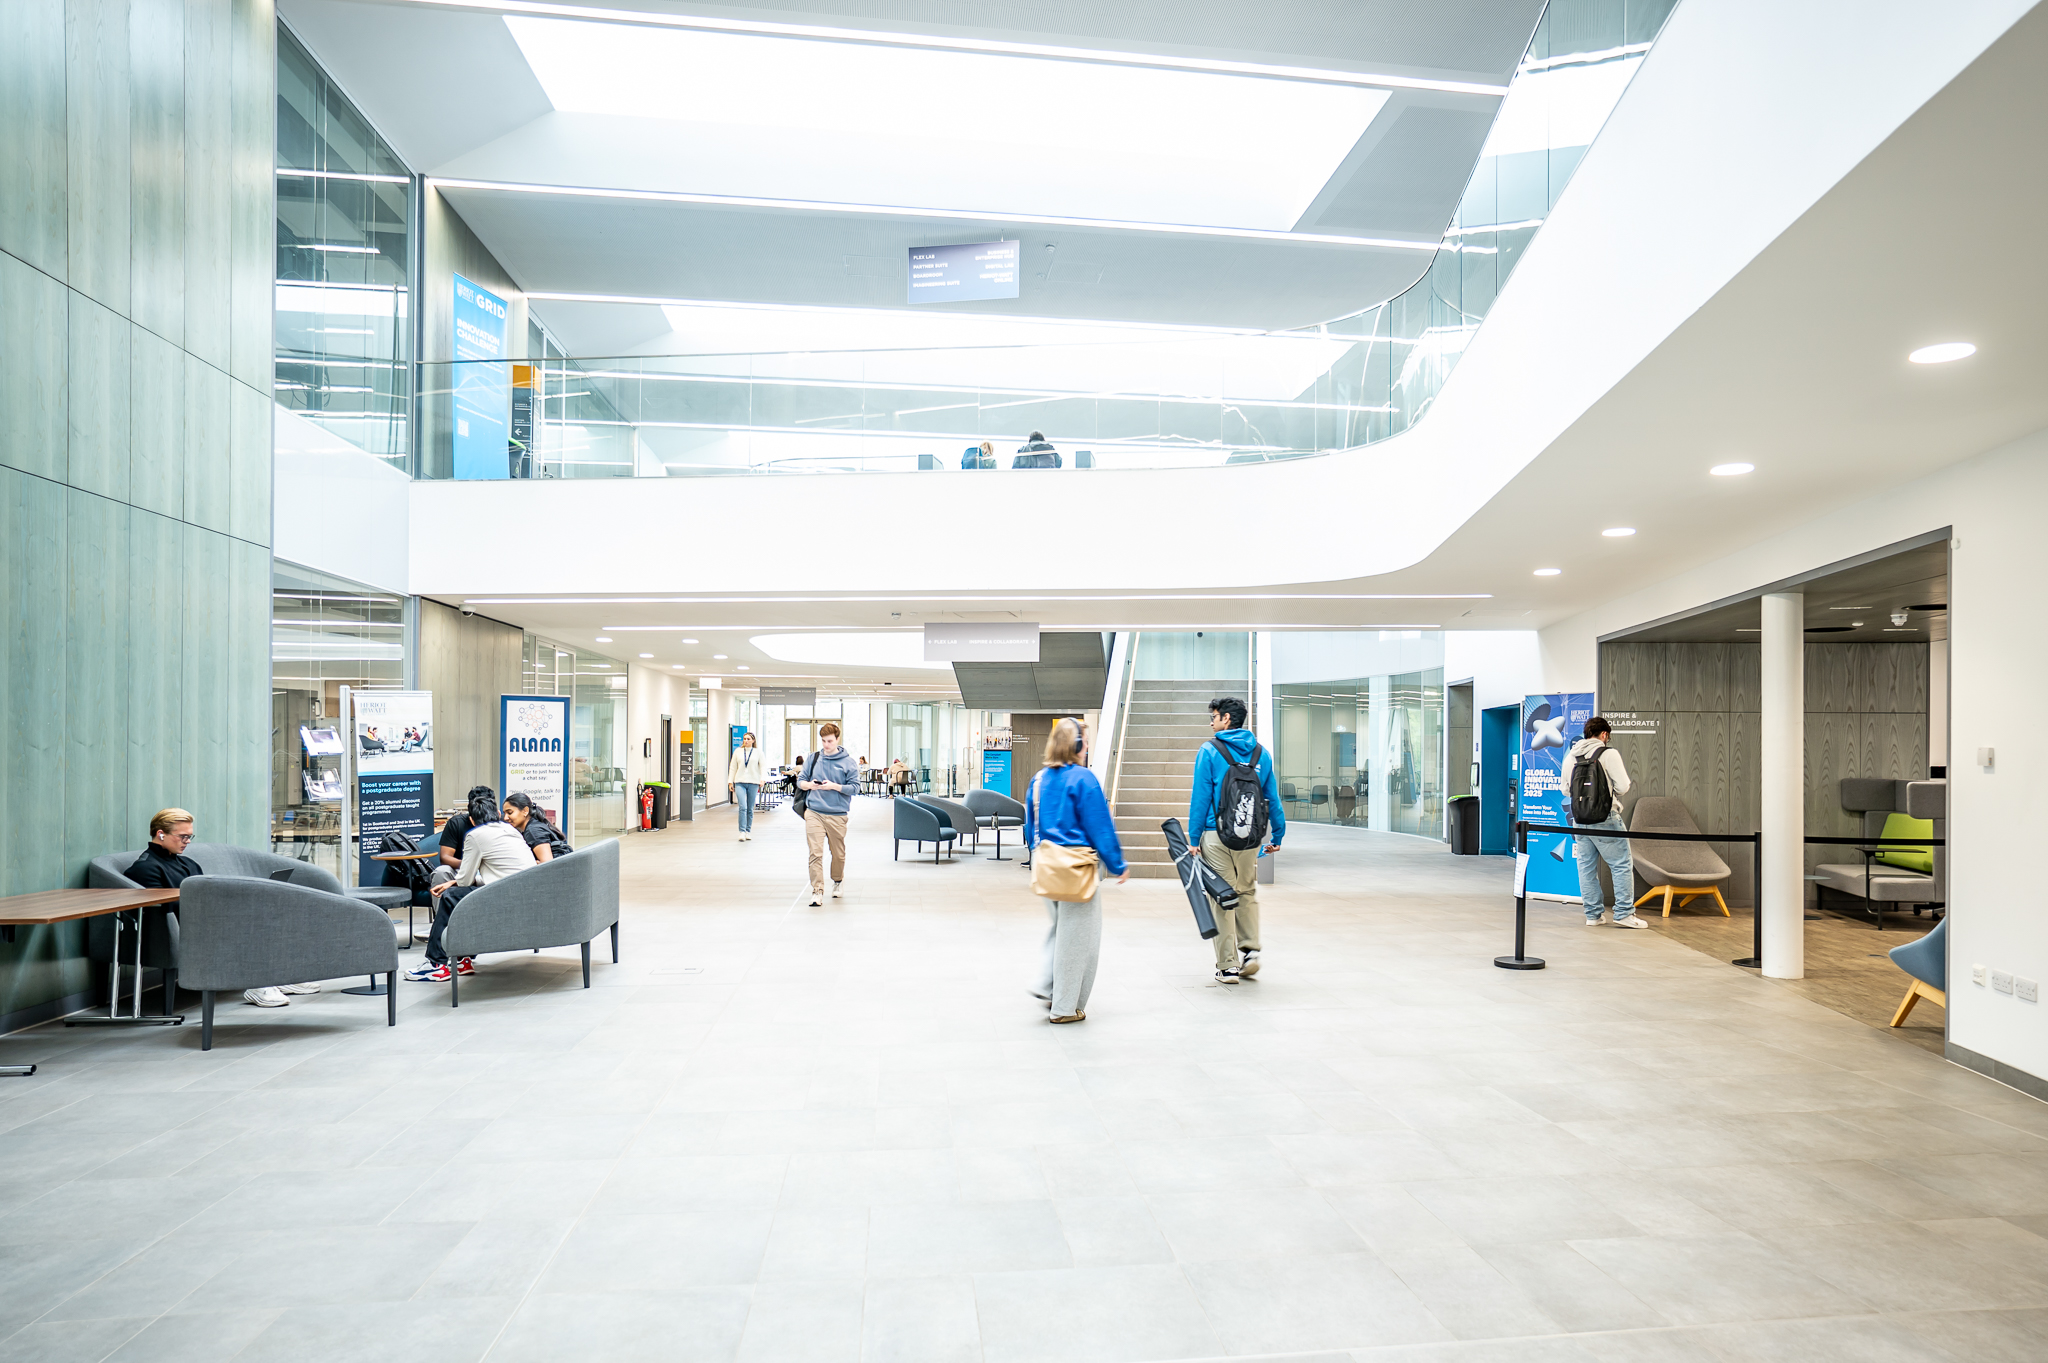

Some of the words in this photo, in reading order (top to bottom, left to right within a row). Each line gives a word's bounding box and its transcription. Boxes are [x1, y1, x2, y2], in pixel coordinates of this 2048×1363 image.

[476, 294, 505, 319] GRID
[457, 318, 500, 347] INNOVATION
[457, 329, 498, 355] CHALLENGE
[510, 737, 561, 752] ALANA
